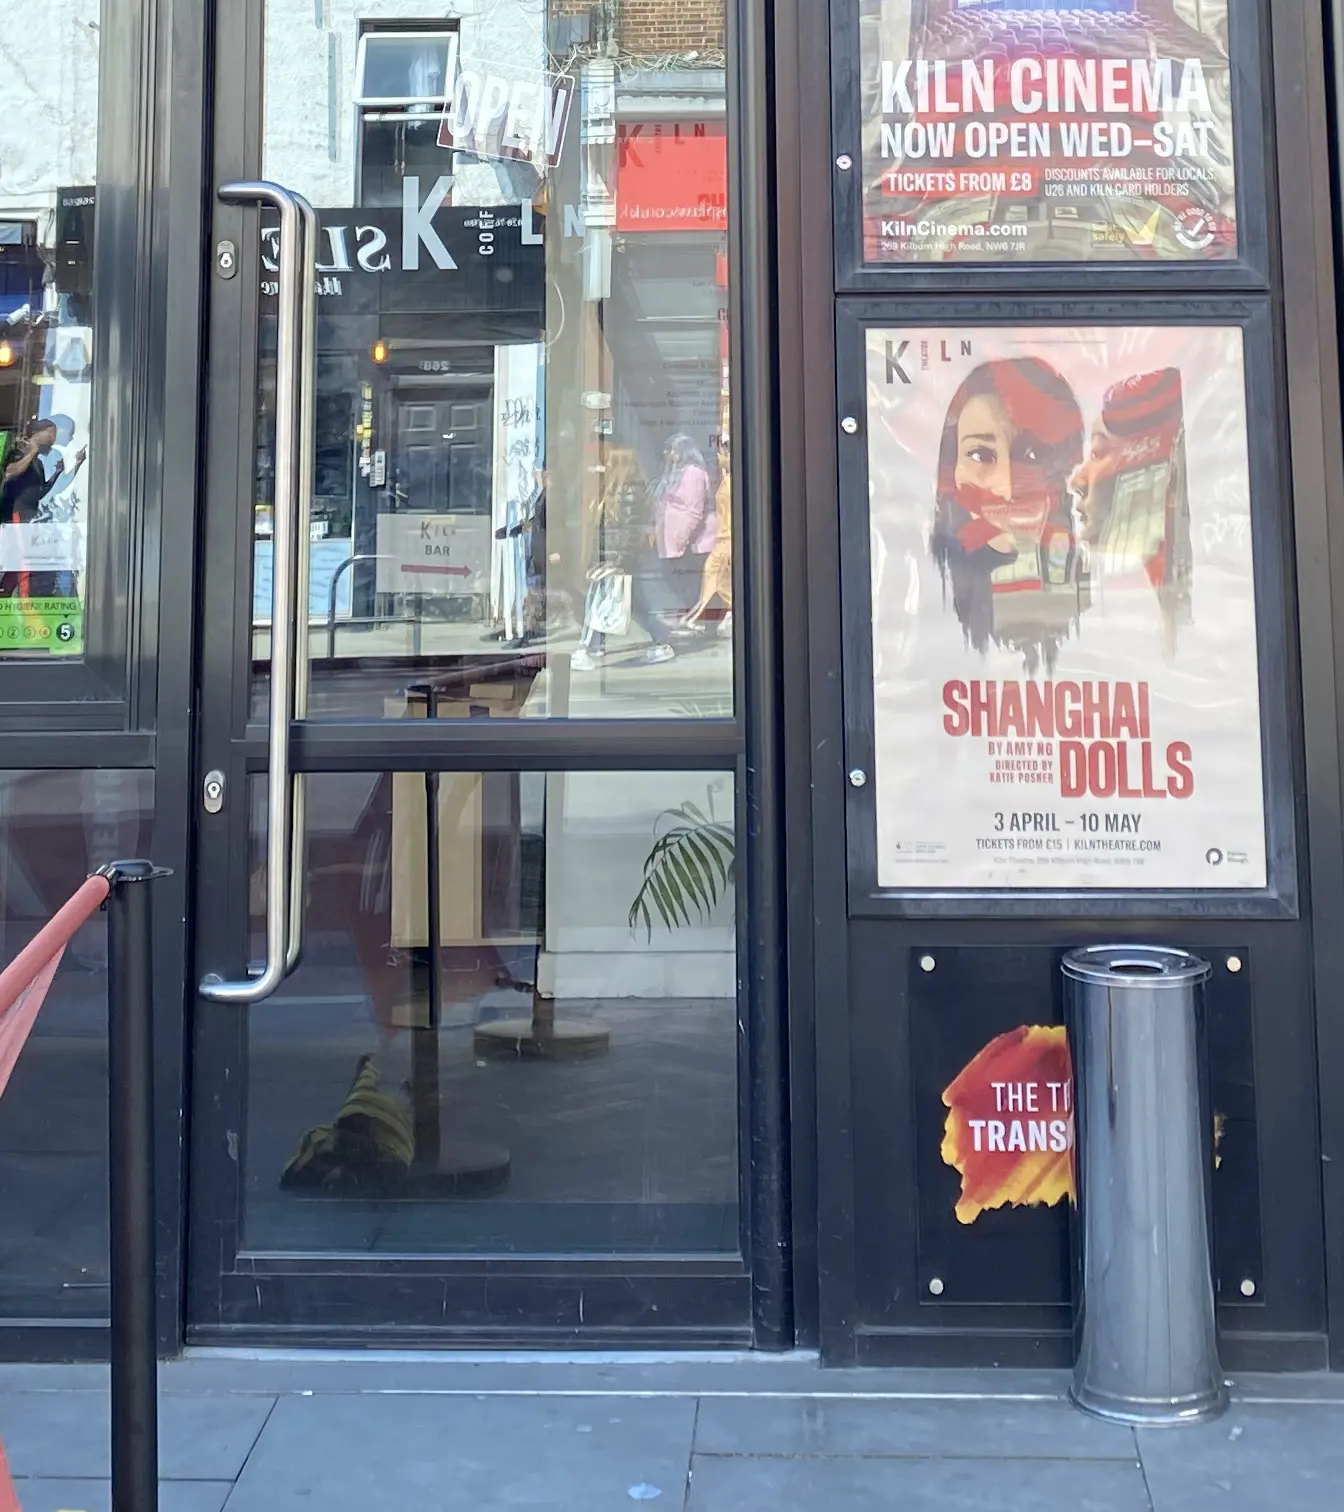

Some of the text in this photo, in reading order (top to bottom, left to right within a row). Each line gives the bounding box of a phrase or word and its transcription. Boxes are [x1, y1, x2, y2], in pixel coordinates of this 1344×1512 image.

[881, 58, 1212, 114] KILN CINEMA
[447, 69, 567, 156] OPEN
[880, 121, 956, 158] NOW
[964, 121, 1051, 158] OPEN
[887, 172, 1032, 192] TICKETS FROM £8
[1044, 168, 1101, 181] DISCOUNTS
[1102, 168, 1154, 181] AVAILABLE
[1156, 168, 1178, 181] FOR
[1044, 183, 1189, 197] U26 AND KILN CARD HOLDERS
[881, 220, 1028, 237] KilnCinema.com
[425, 544, 451, 557] BAR
[44, 601, 77, 610] RATING
[60, 622, 71, 640] 5
[942, 679, 1152, 739] SHANGHAI
[988, 742, 1053, 756] BY AMY NG
[995, 759, 1053, 771] DIRECTED BY
[1059, 740, 1195, 800] DOLLS
[989, 772, 1054, 784] KATIE POSNER
[994, 812, 1004, 832] 3
[1009, 812, 1060, 832] APRIL
[1079, 813, 1099, 832] 10
[1105, 813, 1143, 833] MAY
[976, 838, 1162, 852] TICKETS FROM £15 KILNTHEATRE.COM
[990, 1082, 1040, 1113] THE
